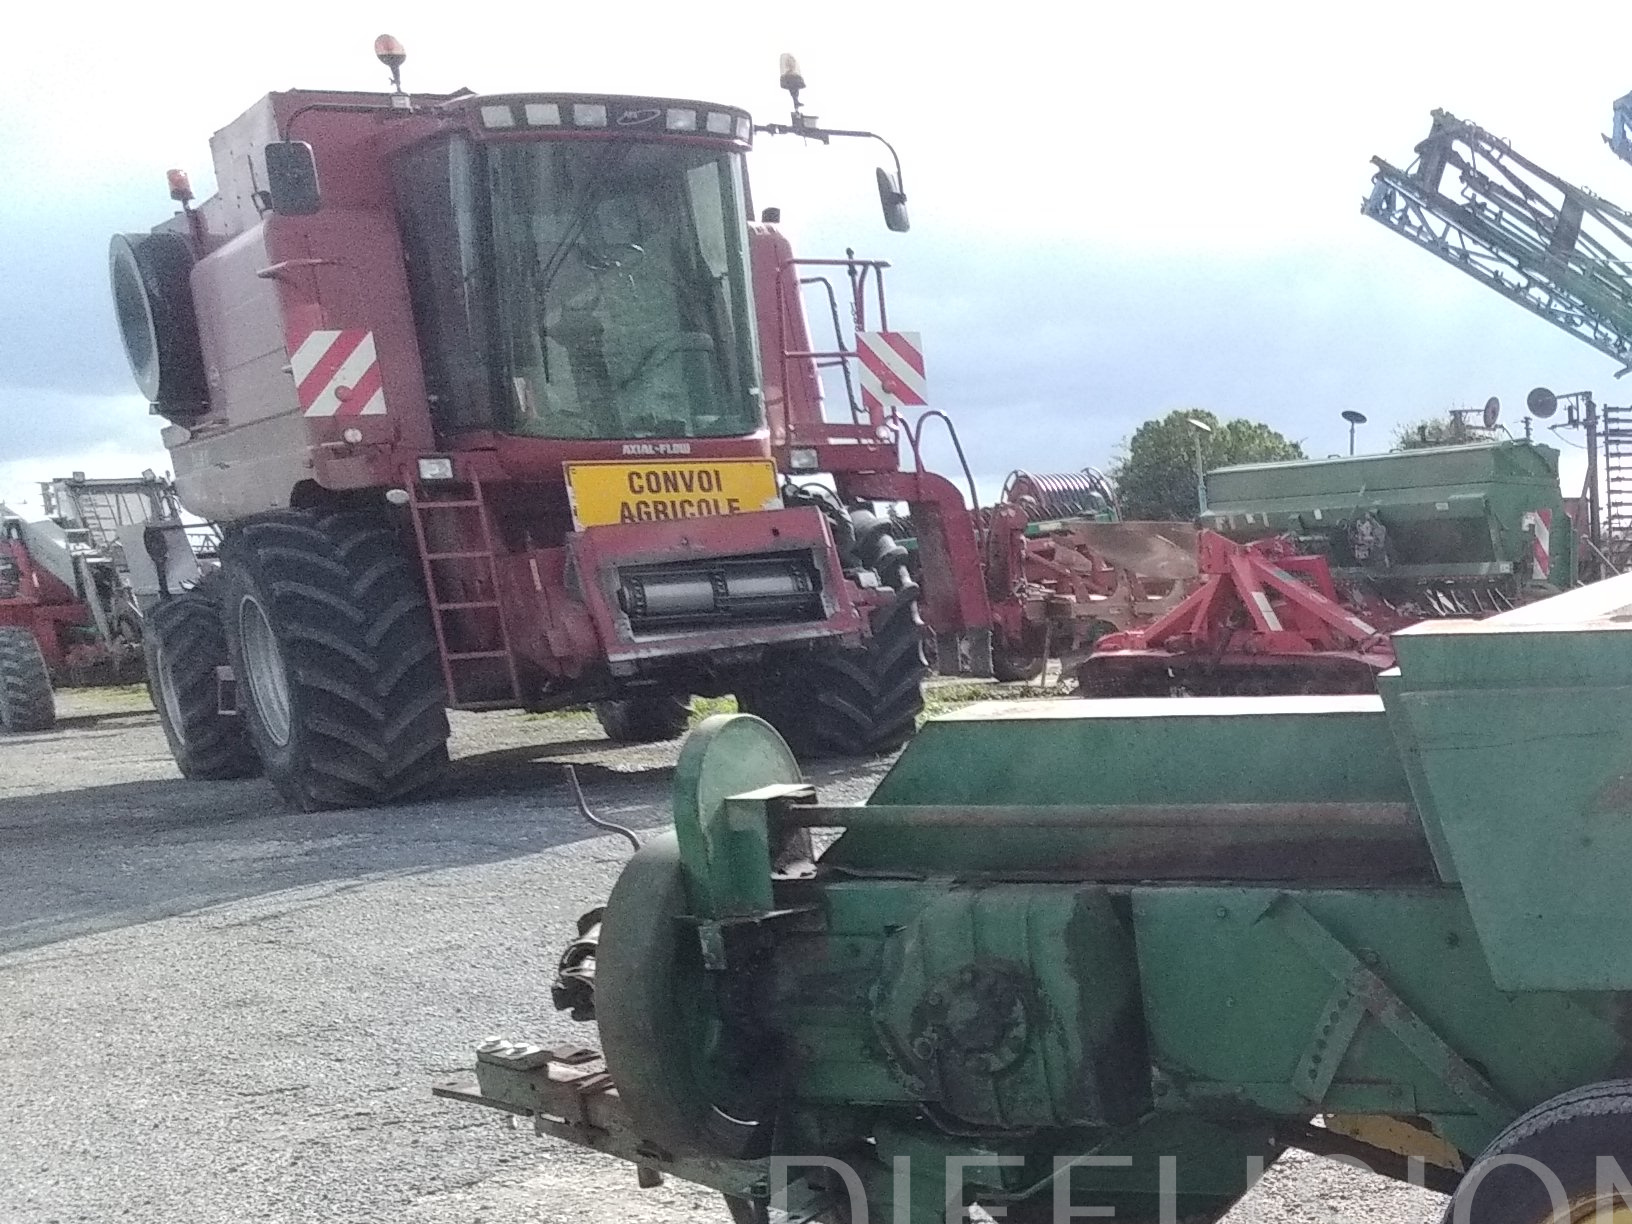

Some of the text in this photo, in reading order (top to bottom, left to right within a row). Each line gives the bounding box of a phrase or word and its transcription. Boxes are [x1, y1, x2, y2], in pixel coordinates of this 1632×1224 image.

[622, 443, 691, 456] AXIAL-FLOW
[628, 469, 723, 495] CONVOI
[620, 498, 741, 524] AGRICOLE
